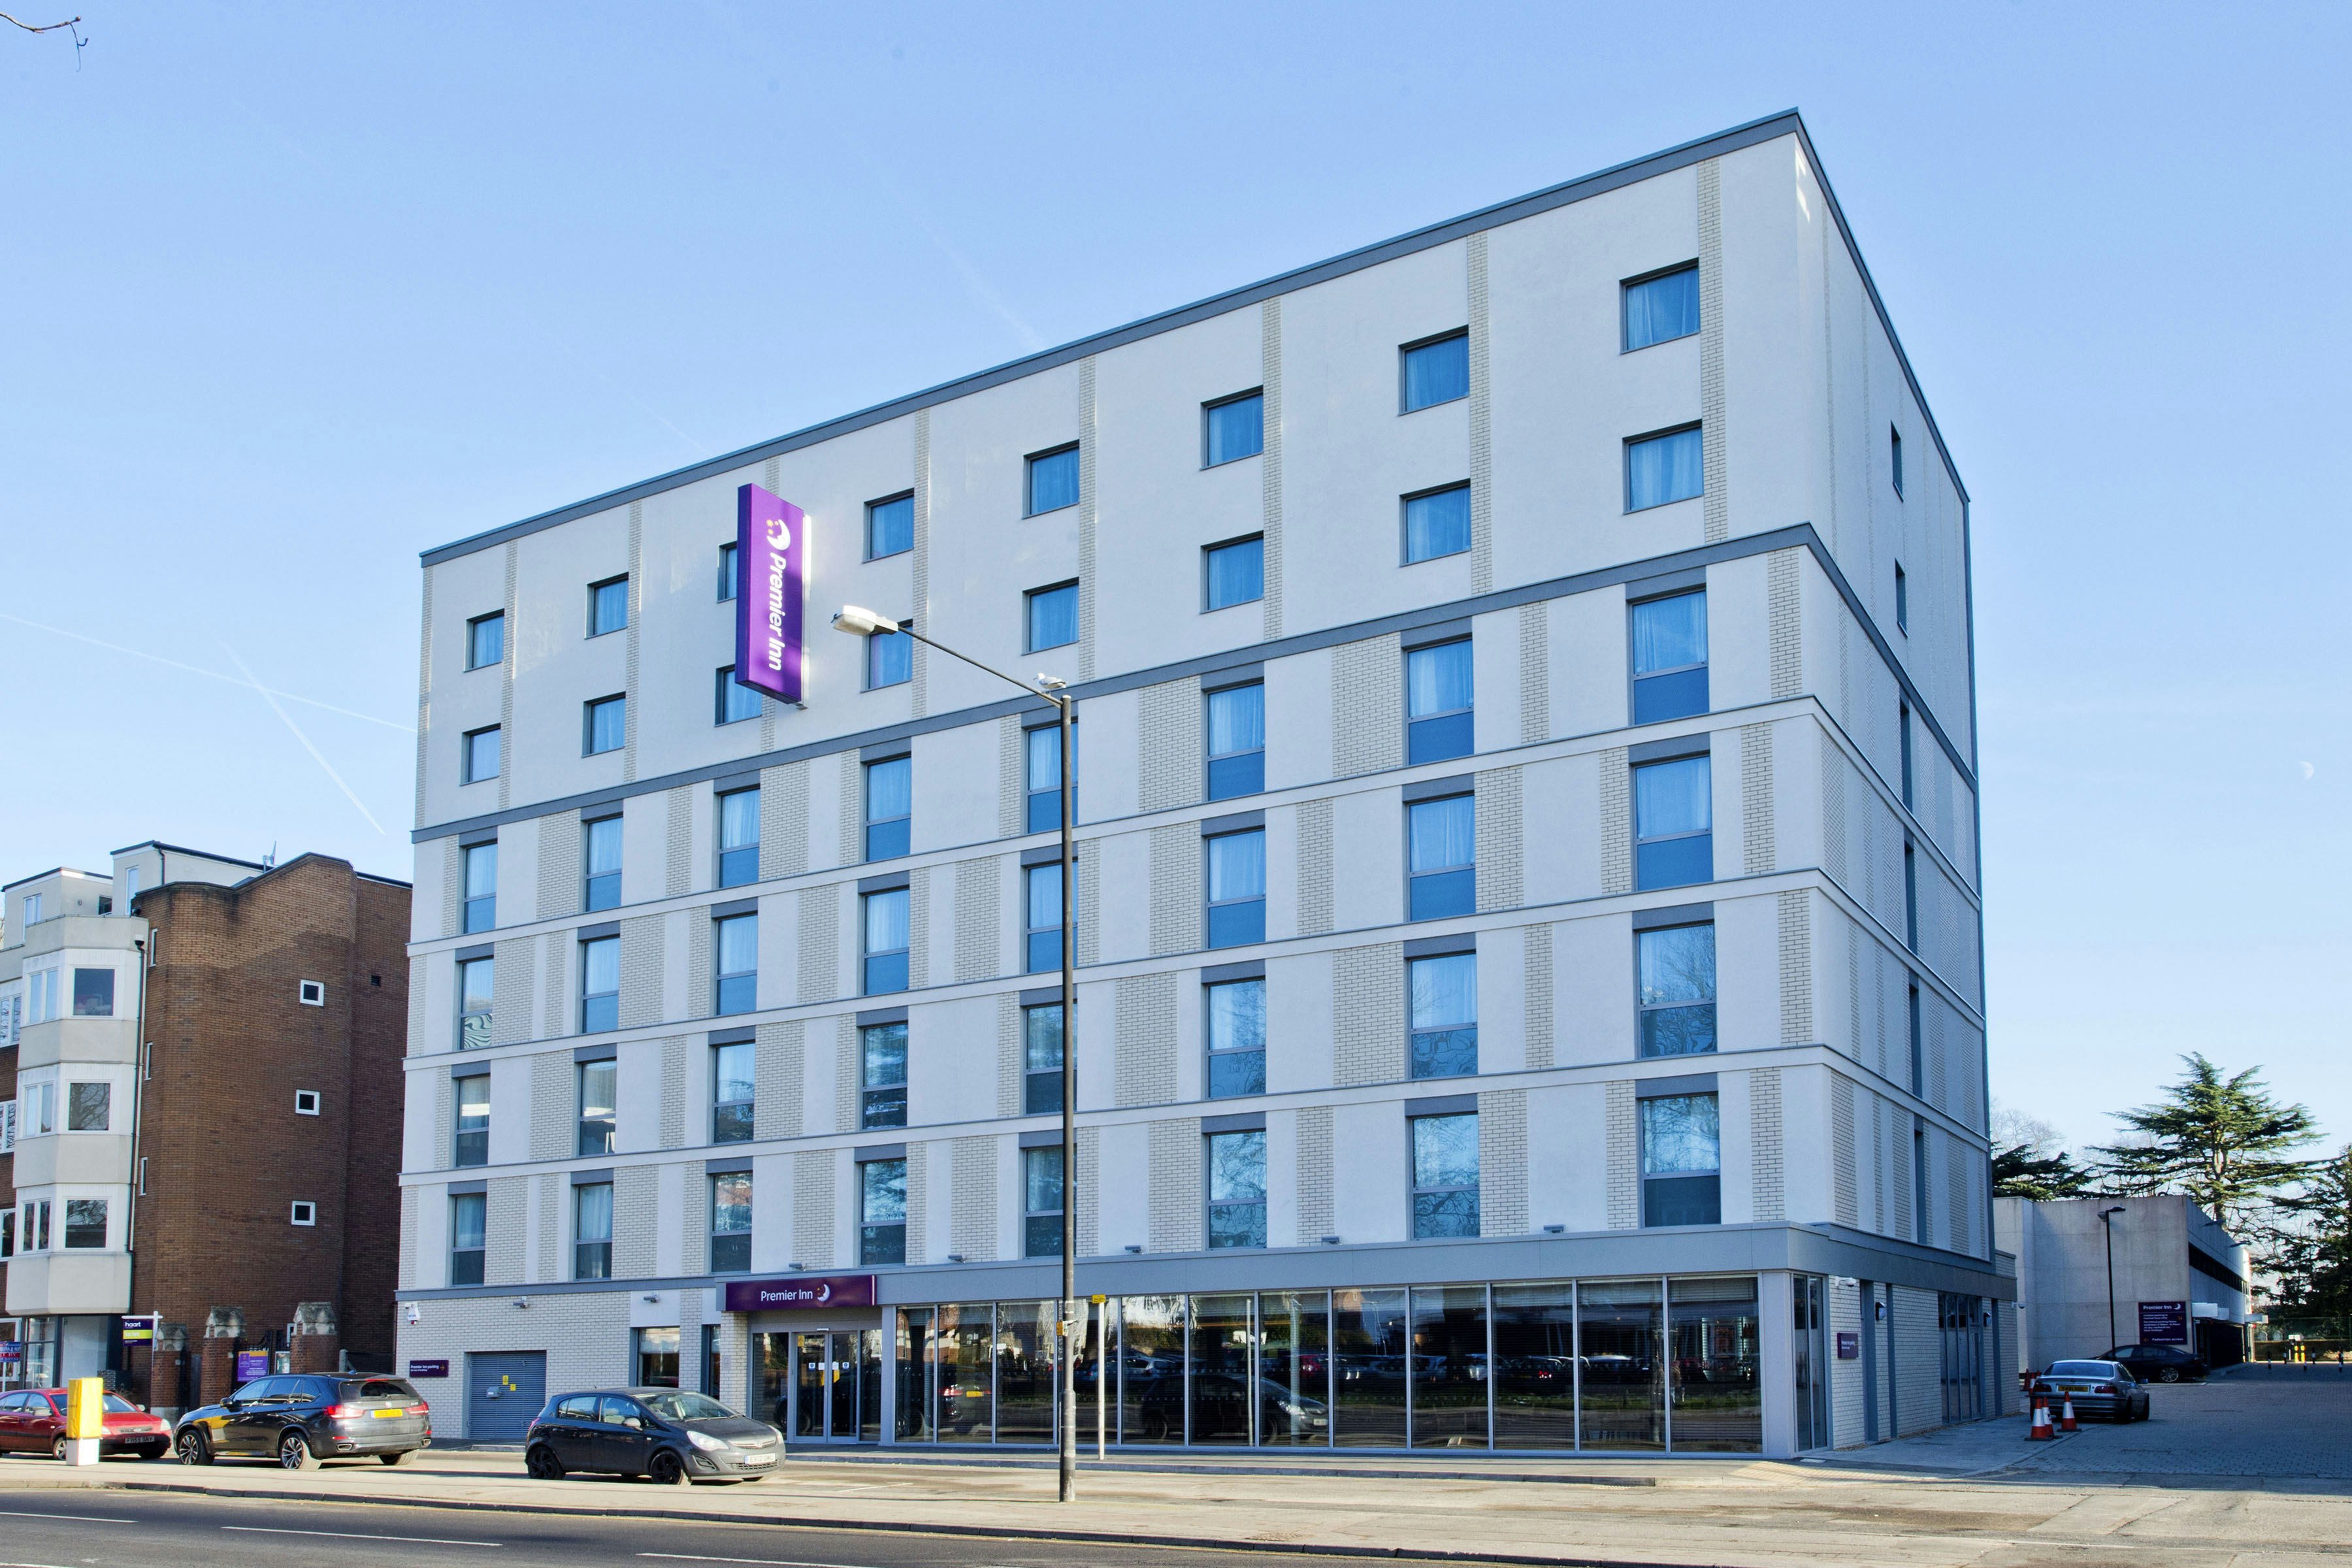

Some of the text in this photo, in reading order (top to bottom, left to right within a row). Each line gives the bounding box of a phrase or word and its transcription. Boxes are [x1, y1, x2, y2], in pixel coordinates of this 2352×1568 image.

[769, 552, 787, 671] Premier Inn
[760, 1289, 813, 1301] Premier Inn
